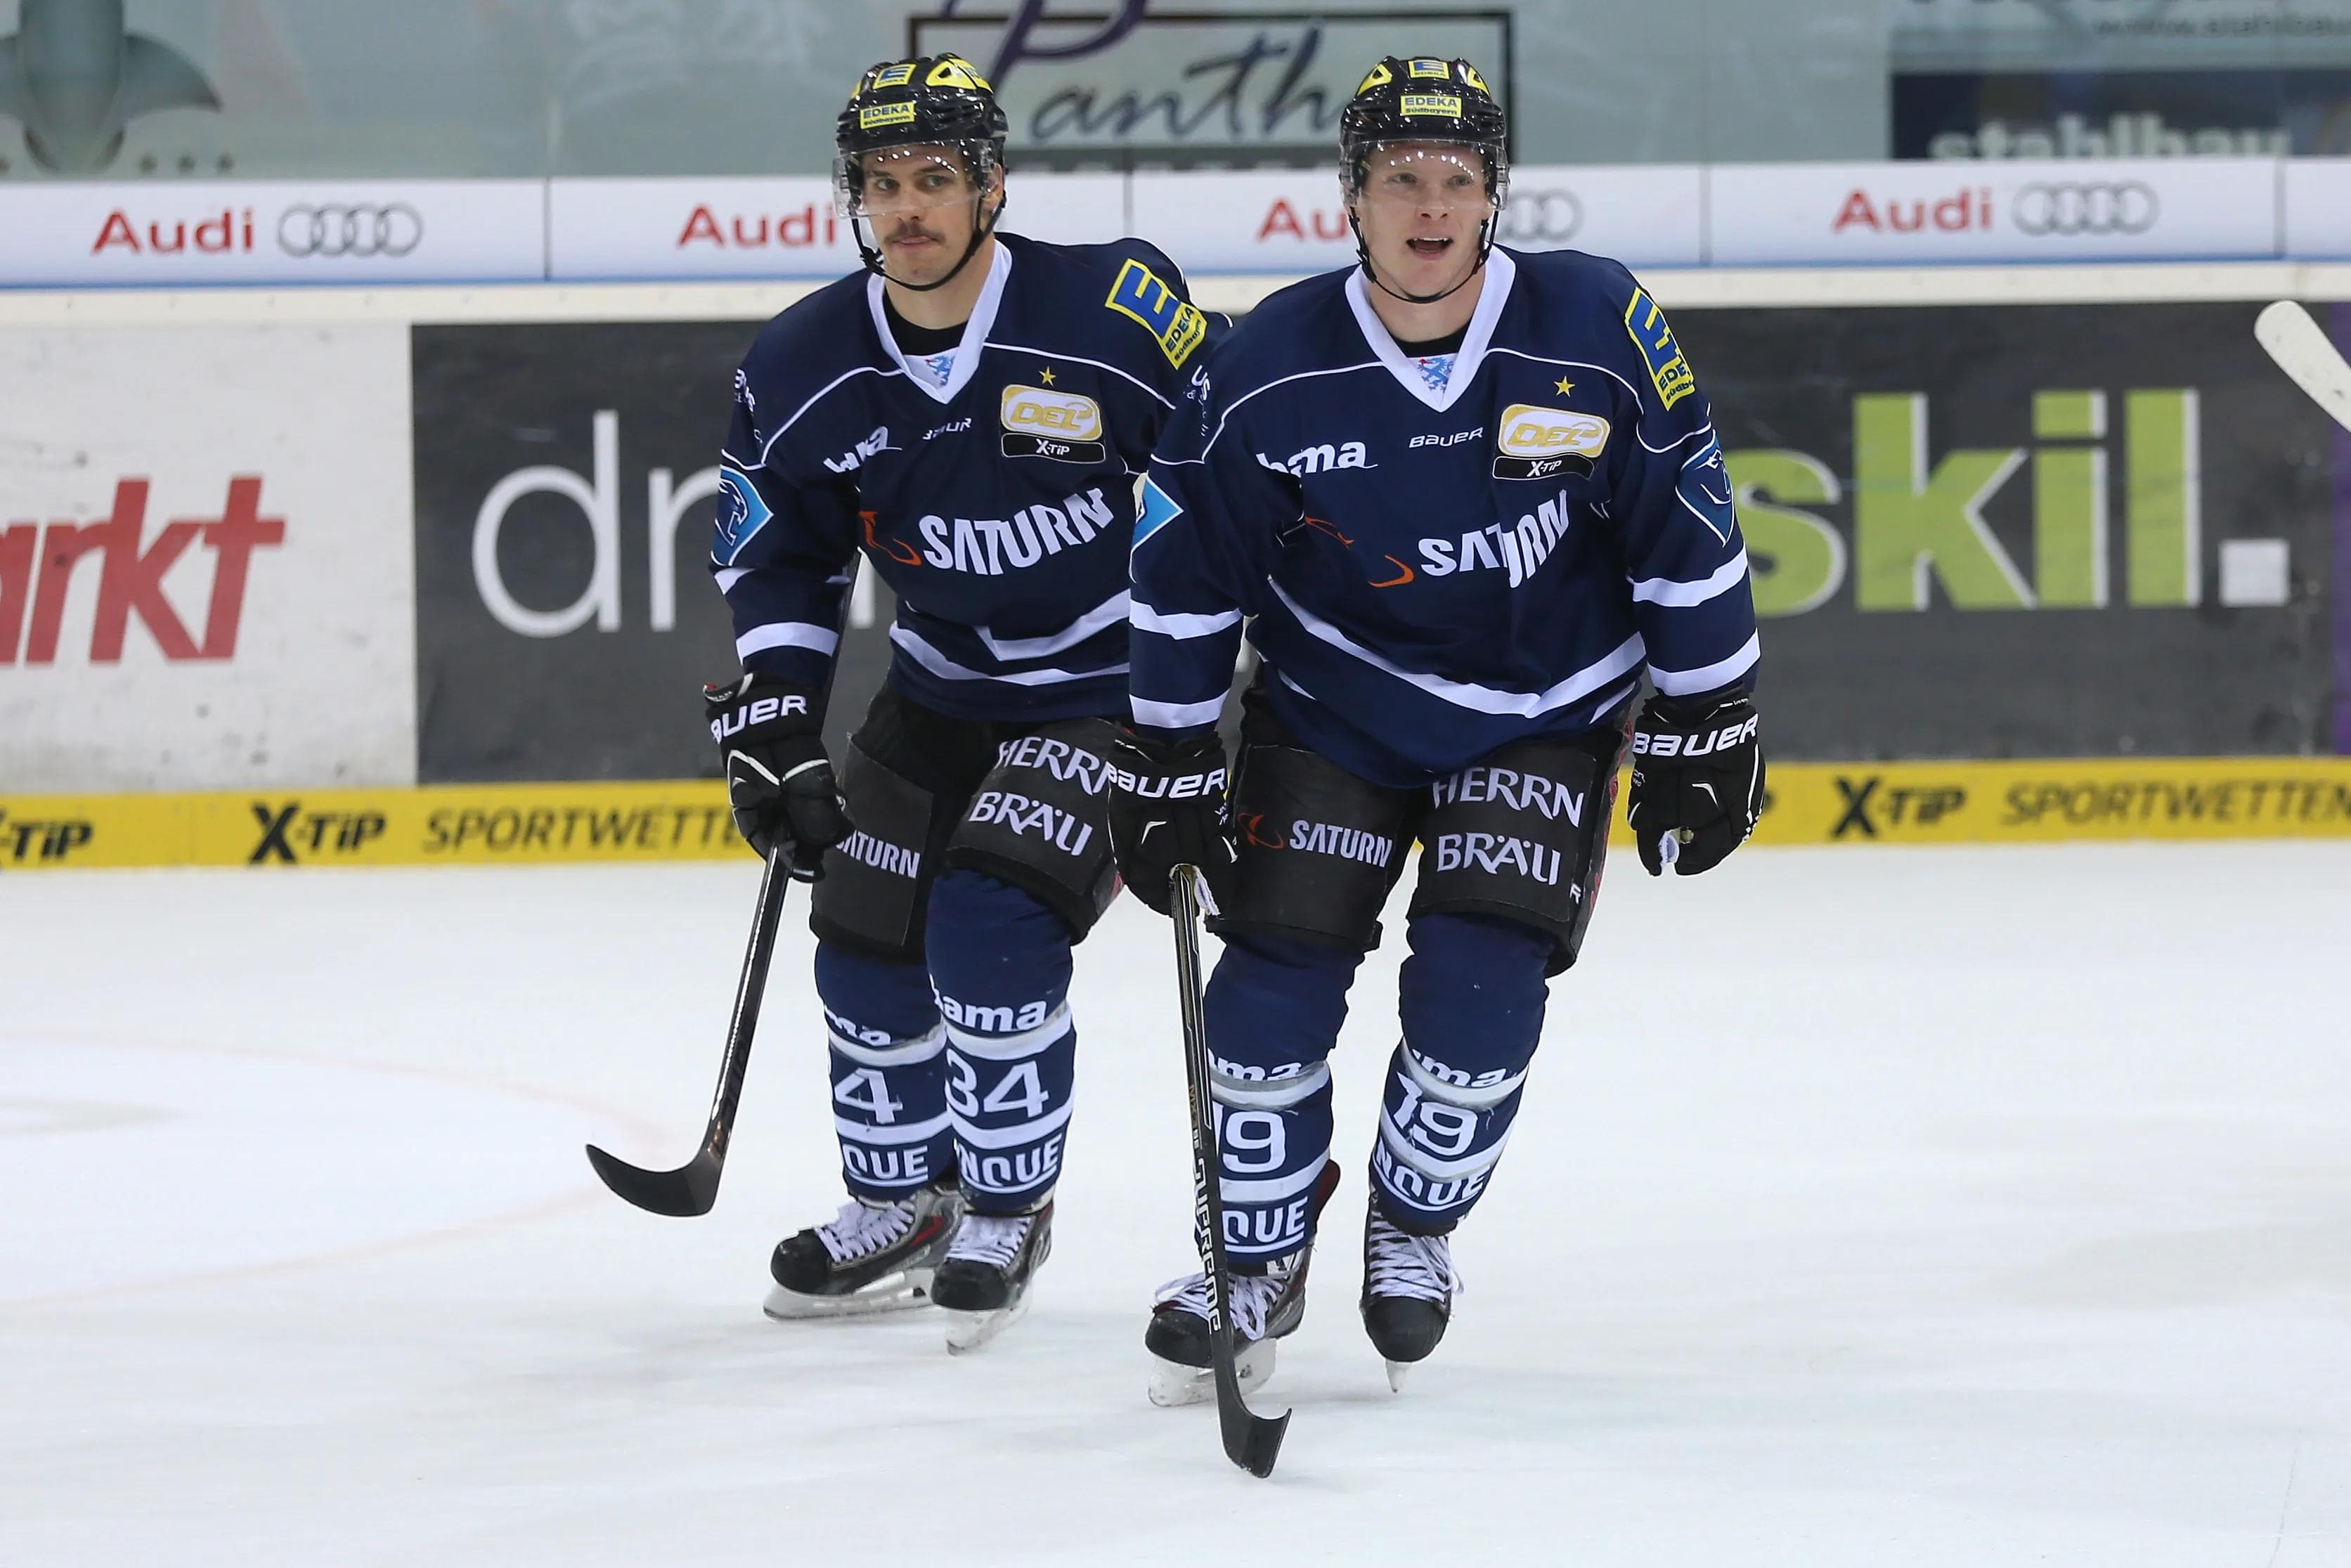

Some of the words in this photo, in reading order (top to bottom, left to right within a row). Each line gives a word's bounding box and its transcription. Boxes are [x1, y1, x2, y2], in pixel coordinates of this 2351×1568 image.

[864, 104, 910, 118] EDEKA
[1405, 97, 1458, 108] EDEKA
[90, 207, 255, 256] Audi
[675, 201, 840, 249] Audi
[1257, 197, 1347, 243] Au
[1831, 186, 1995, 233] Audi
[1165, 306, 1195, 353] EDEKA
[1658, 362, 1690, 390] EDE
[1011, 401, 1082, 432] DEL
[1507, 423, 1581, 447] DEL
[918, 487, 1115, 576] SATURN
[1418, 488, 1569, 588] SATURN
[711, 694, 808, 745] AUER
[1432, 766, 1585, 828] HERRN
[968, 791, 1093, 857] BRÄU
[1289, 819, 1393, 868] SATURN
[836, 829, 921, 879] ATURN
[1437, 831, 1562, 886] BRÄU
[834, 1067, 904, 1125] 4
[947, 1048, 1049, 1119] 34
[1393, 1071, 1479, 1157] 19
